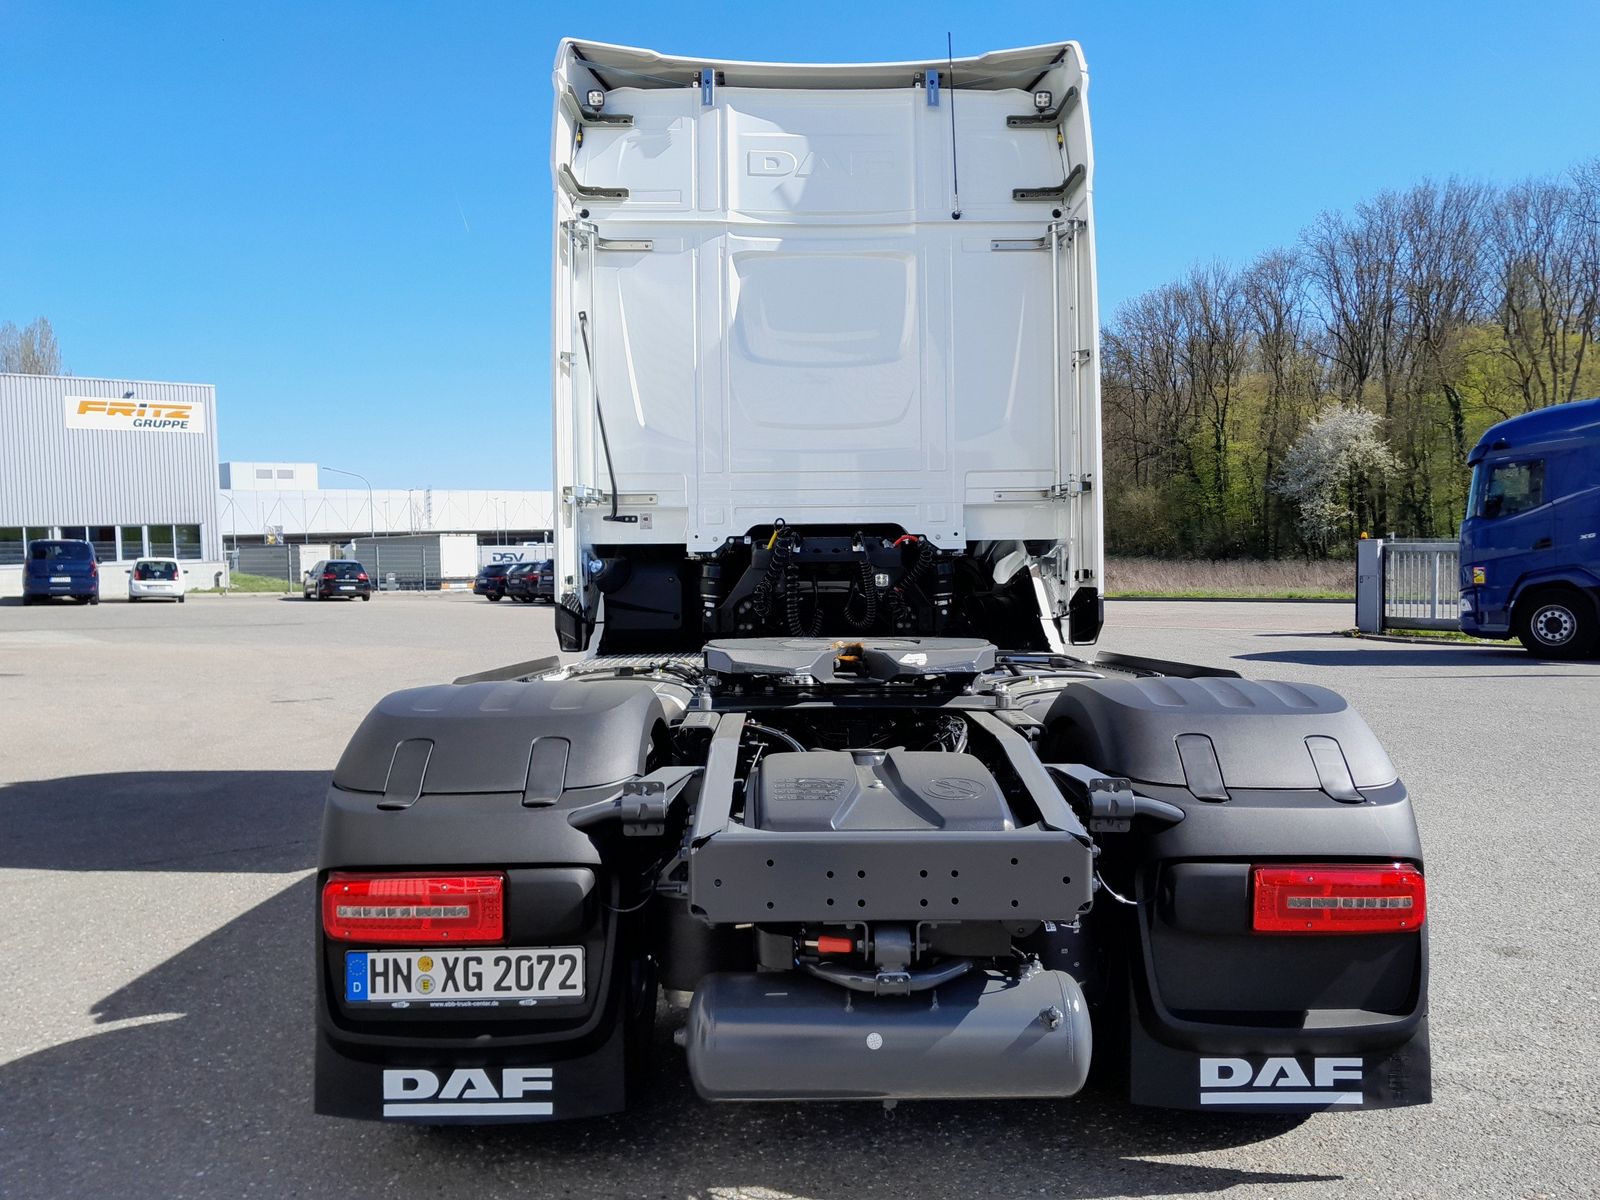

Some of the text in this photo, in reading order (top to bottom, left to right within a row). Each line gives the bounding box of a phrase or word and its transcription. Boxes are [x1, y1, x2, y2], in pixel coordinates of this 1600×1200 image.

[133, 418, 189, 430] GRUPPE
[492, 553, 525, 562] DSV
[353, 954, 578, 994] D HN XG 2072
[383, 1068, 553, 1100] DAF
[1200, 1057, 1364, 1088] DAF
